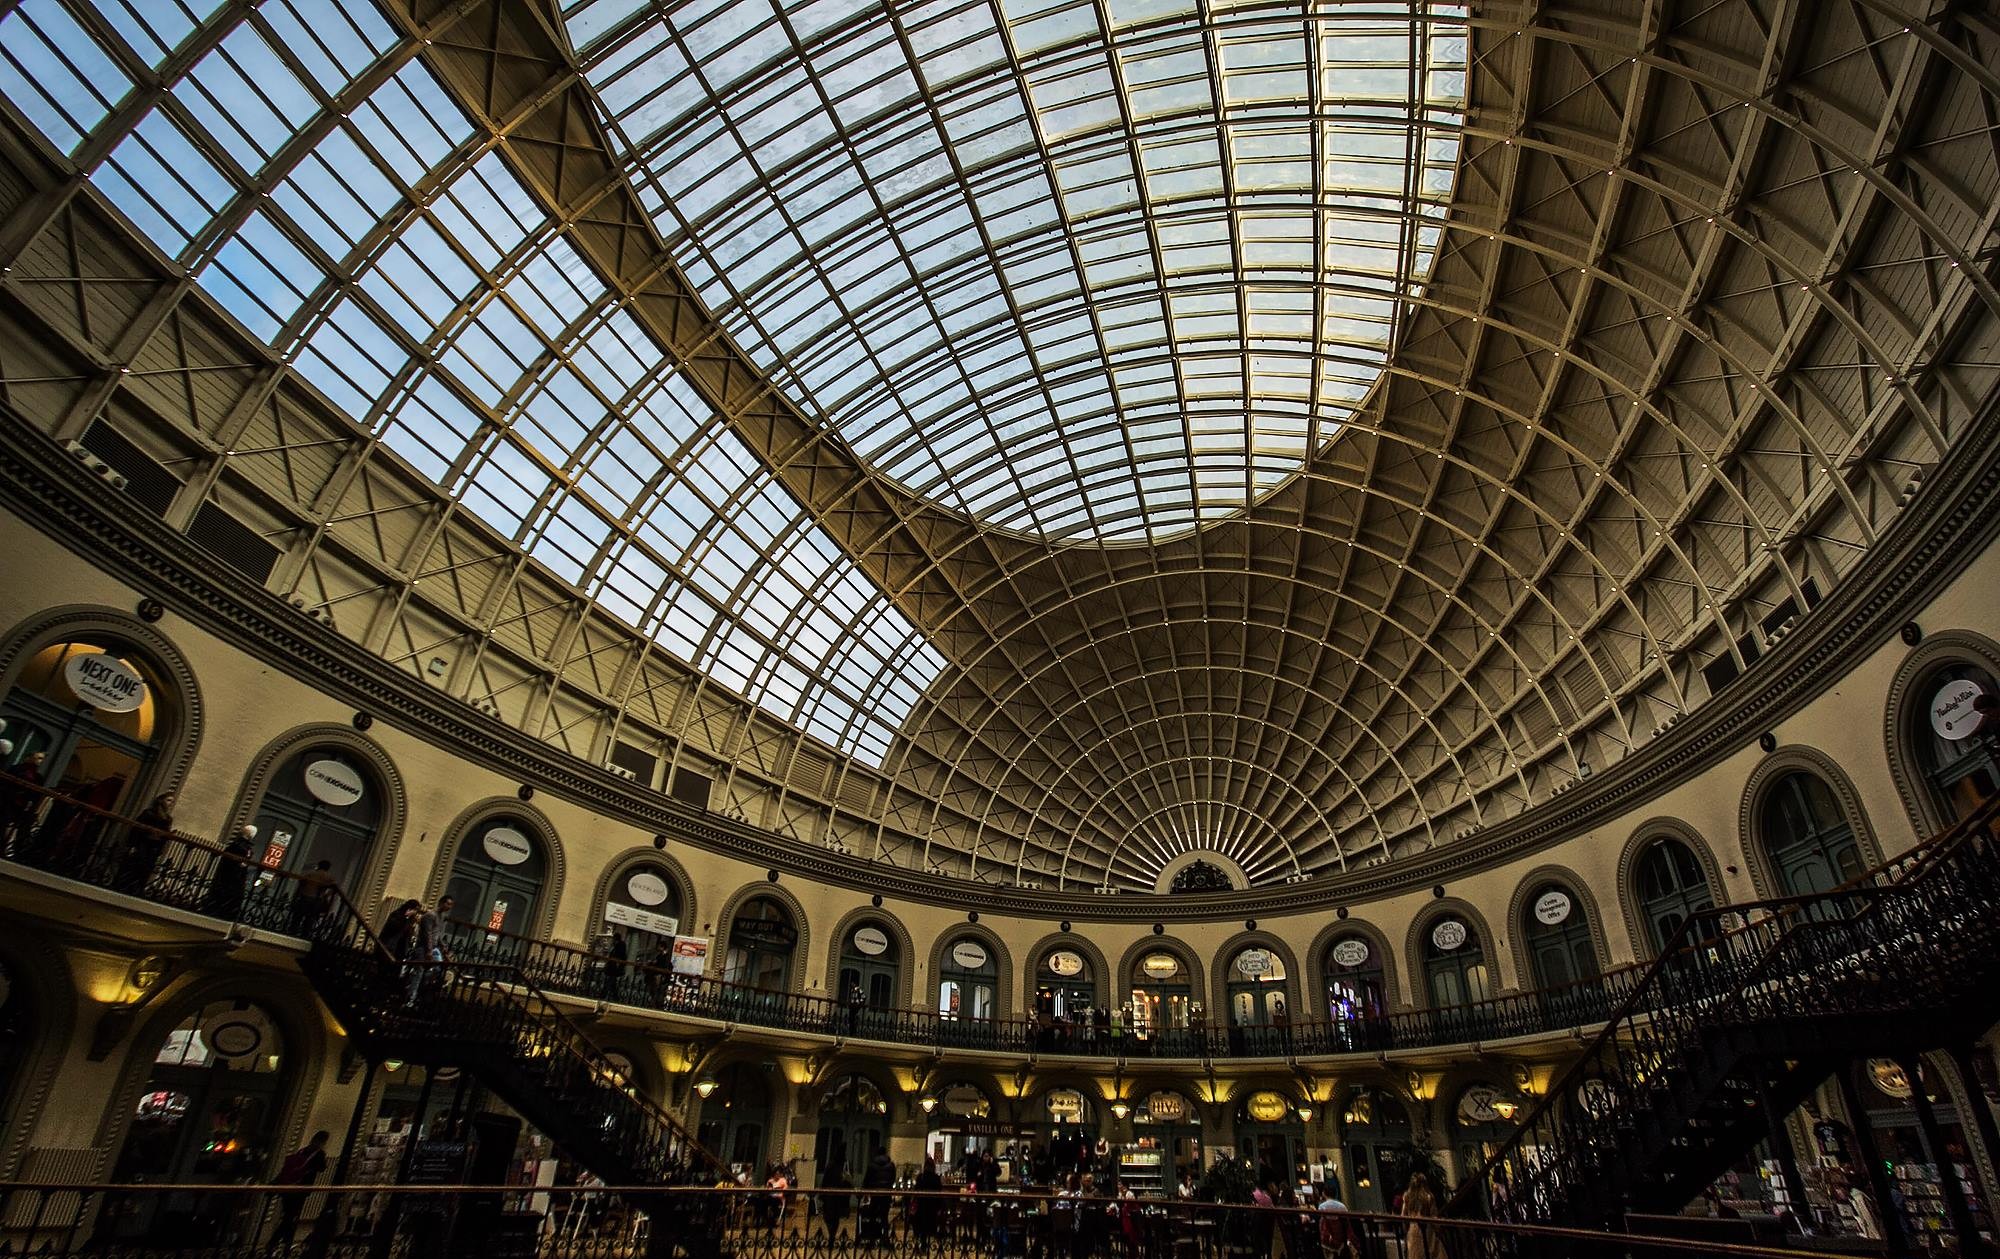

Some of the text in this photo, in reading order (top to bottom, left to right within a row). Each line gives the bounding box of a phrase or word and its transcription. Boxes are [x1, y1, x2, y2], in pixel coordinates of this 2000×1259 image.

[79, 657, 140, 697] NEXT ONE
[270, 846, 283, 858] TO
[264, 855, 281, 867] LET
